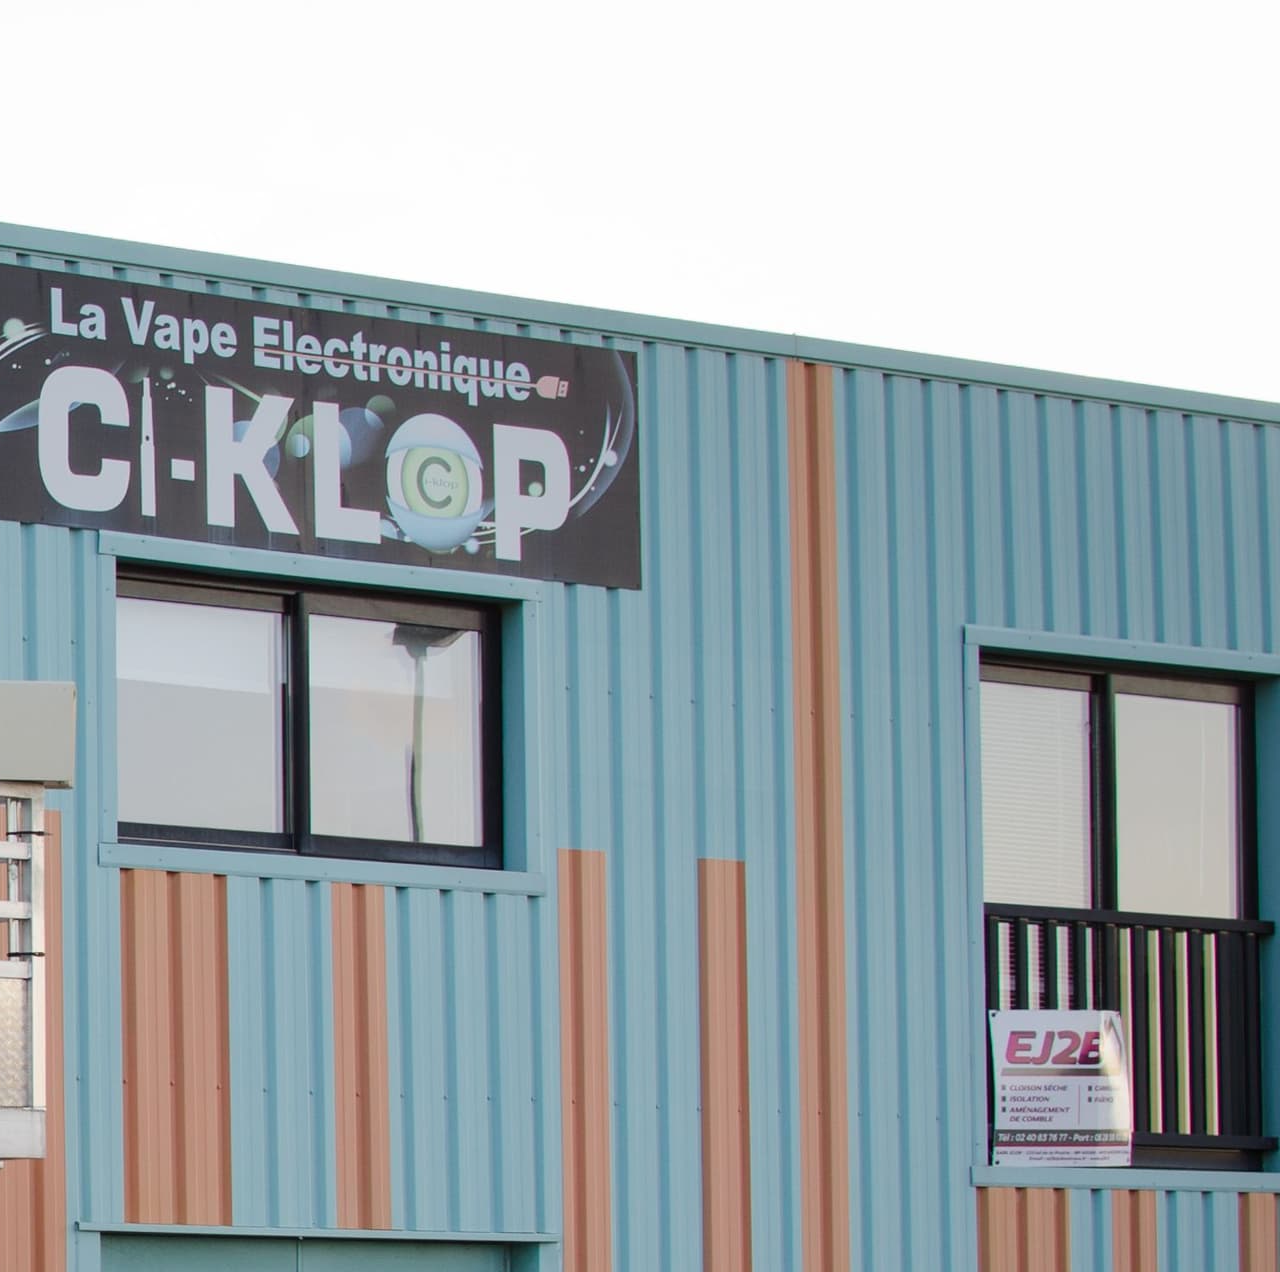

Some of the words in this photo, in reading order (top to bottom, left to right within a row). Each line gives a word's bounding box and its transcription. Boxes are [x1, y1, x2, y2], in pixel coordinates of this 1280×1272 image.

[50, 287, 106, 340] La
[120, 297, 237, 364] Vape
[252, 315, 531, 407] Electronique
[1009, 1105, 1071, 1113] AMÉNAGEMENT
